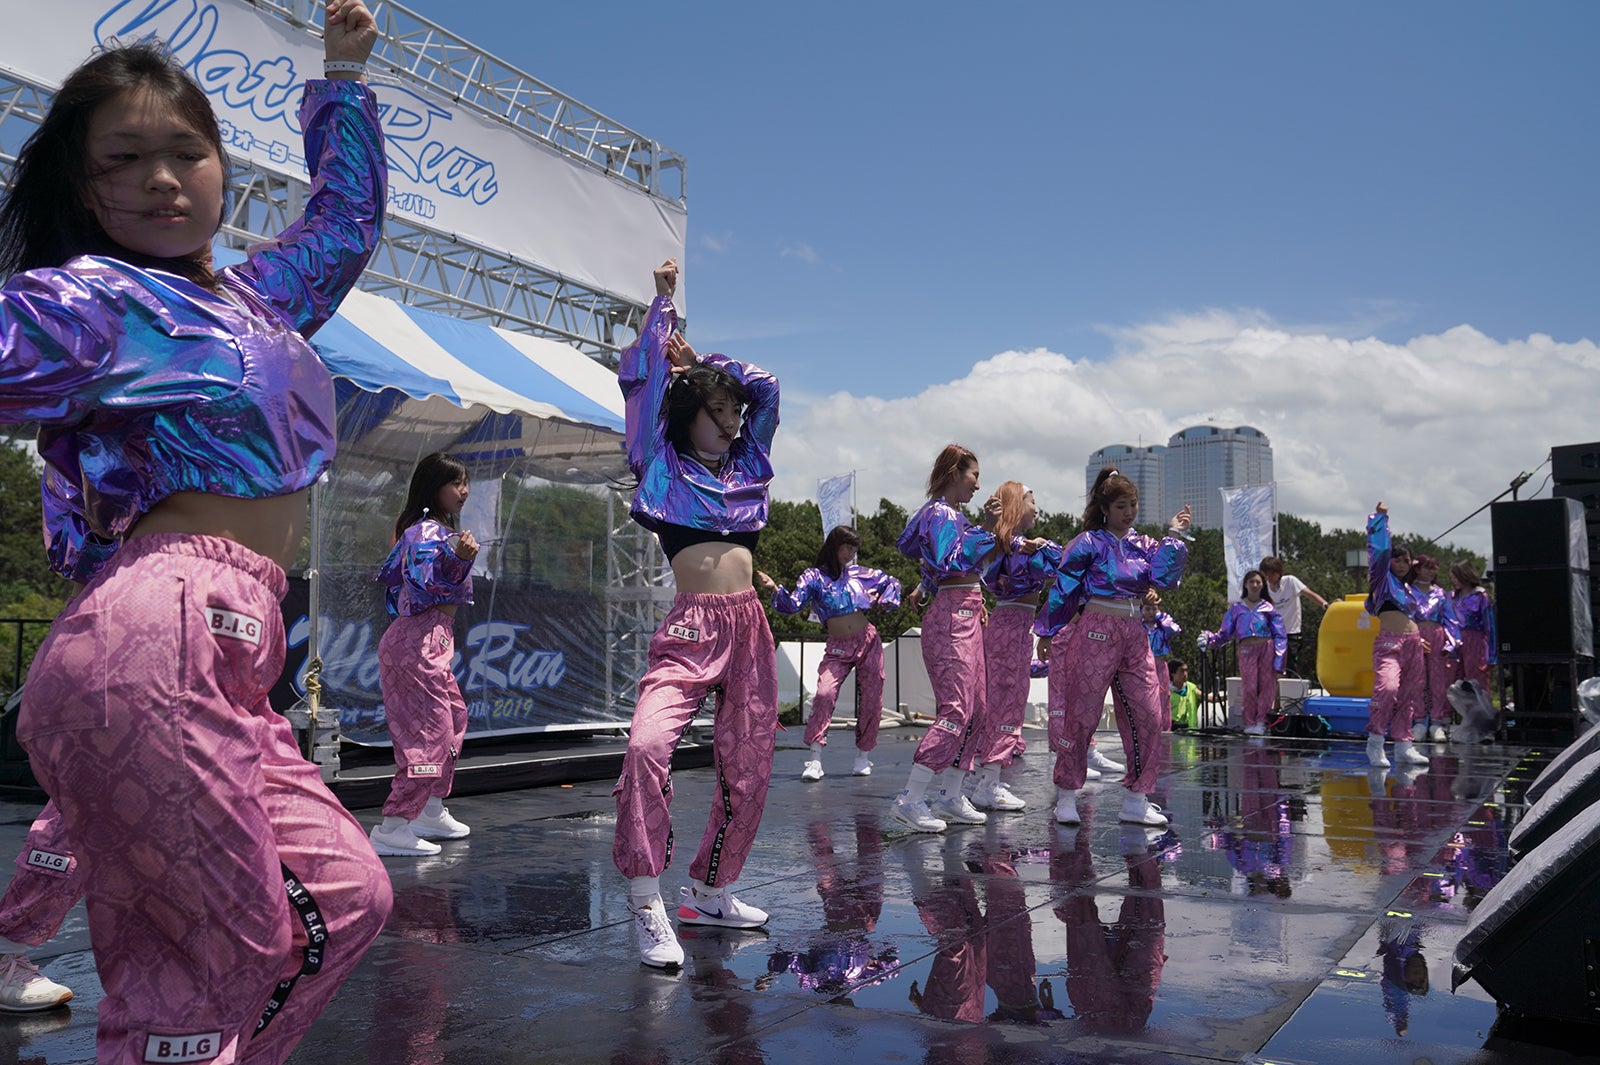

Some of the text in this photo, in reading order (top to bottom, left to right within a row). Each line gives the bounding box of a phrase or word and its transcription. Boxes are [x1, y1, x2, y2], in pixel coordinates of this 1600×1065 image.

[367, 83, 498, 206] Run
[672, 626, 695, 639] B.I.G
[465, 620, 567, 693] Run
[492, 697, 534, 719] 2019
[33, 853, 64, 868] B.I.G
[304, 911, 325, 943] B.I.G
[157, 1038, 211, 1058] B.I.G
